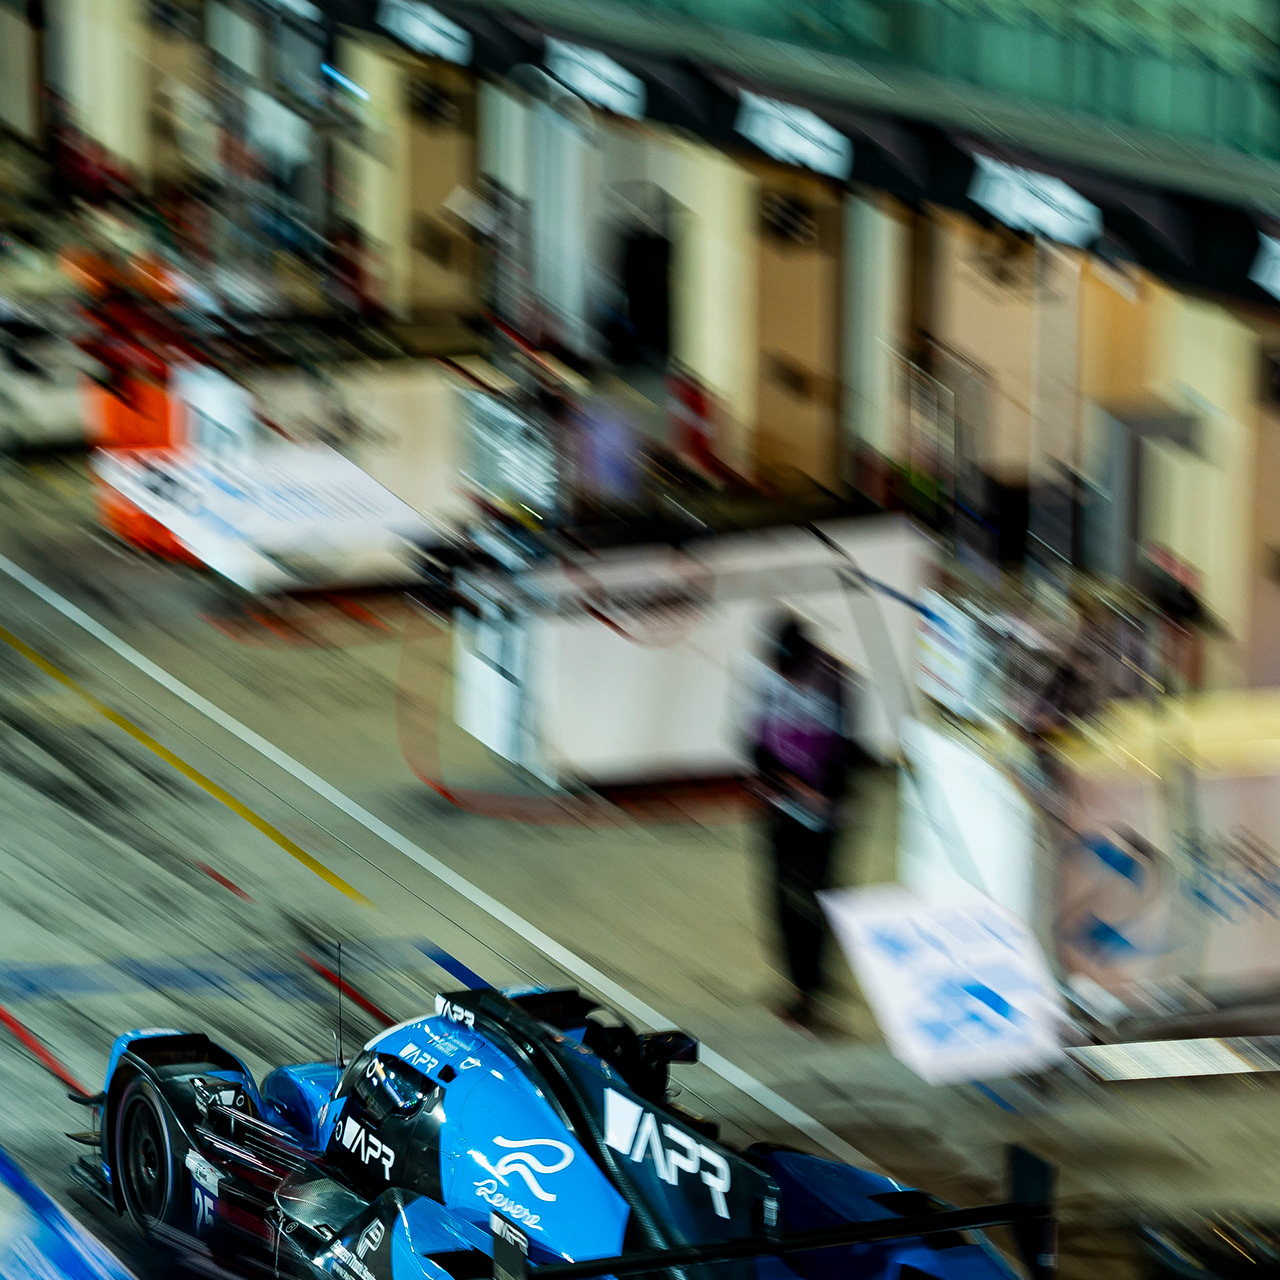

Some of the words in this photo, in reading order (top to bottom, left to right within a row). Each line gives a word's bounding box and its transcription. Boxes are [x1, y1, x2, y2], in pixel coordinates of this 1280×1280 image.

[442, 1000, 475, 1030] APR
[402, 1048, 439, 1074] APR
[350, 1127, 396, 1182] APR
[628, 1112, 732, 1220] APR
[472, 1178, 544, 1229] Revere
